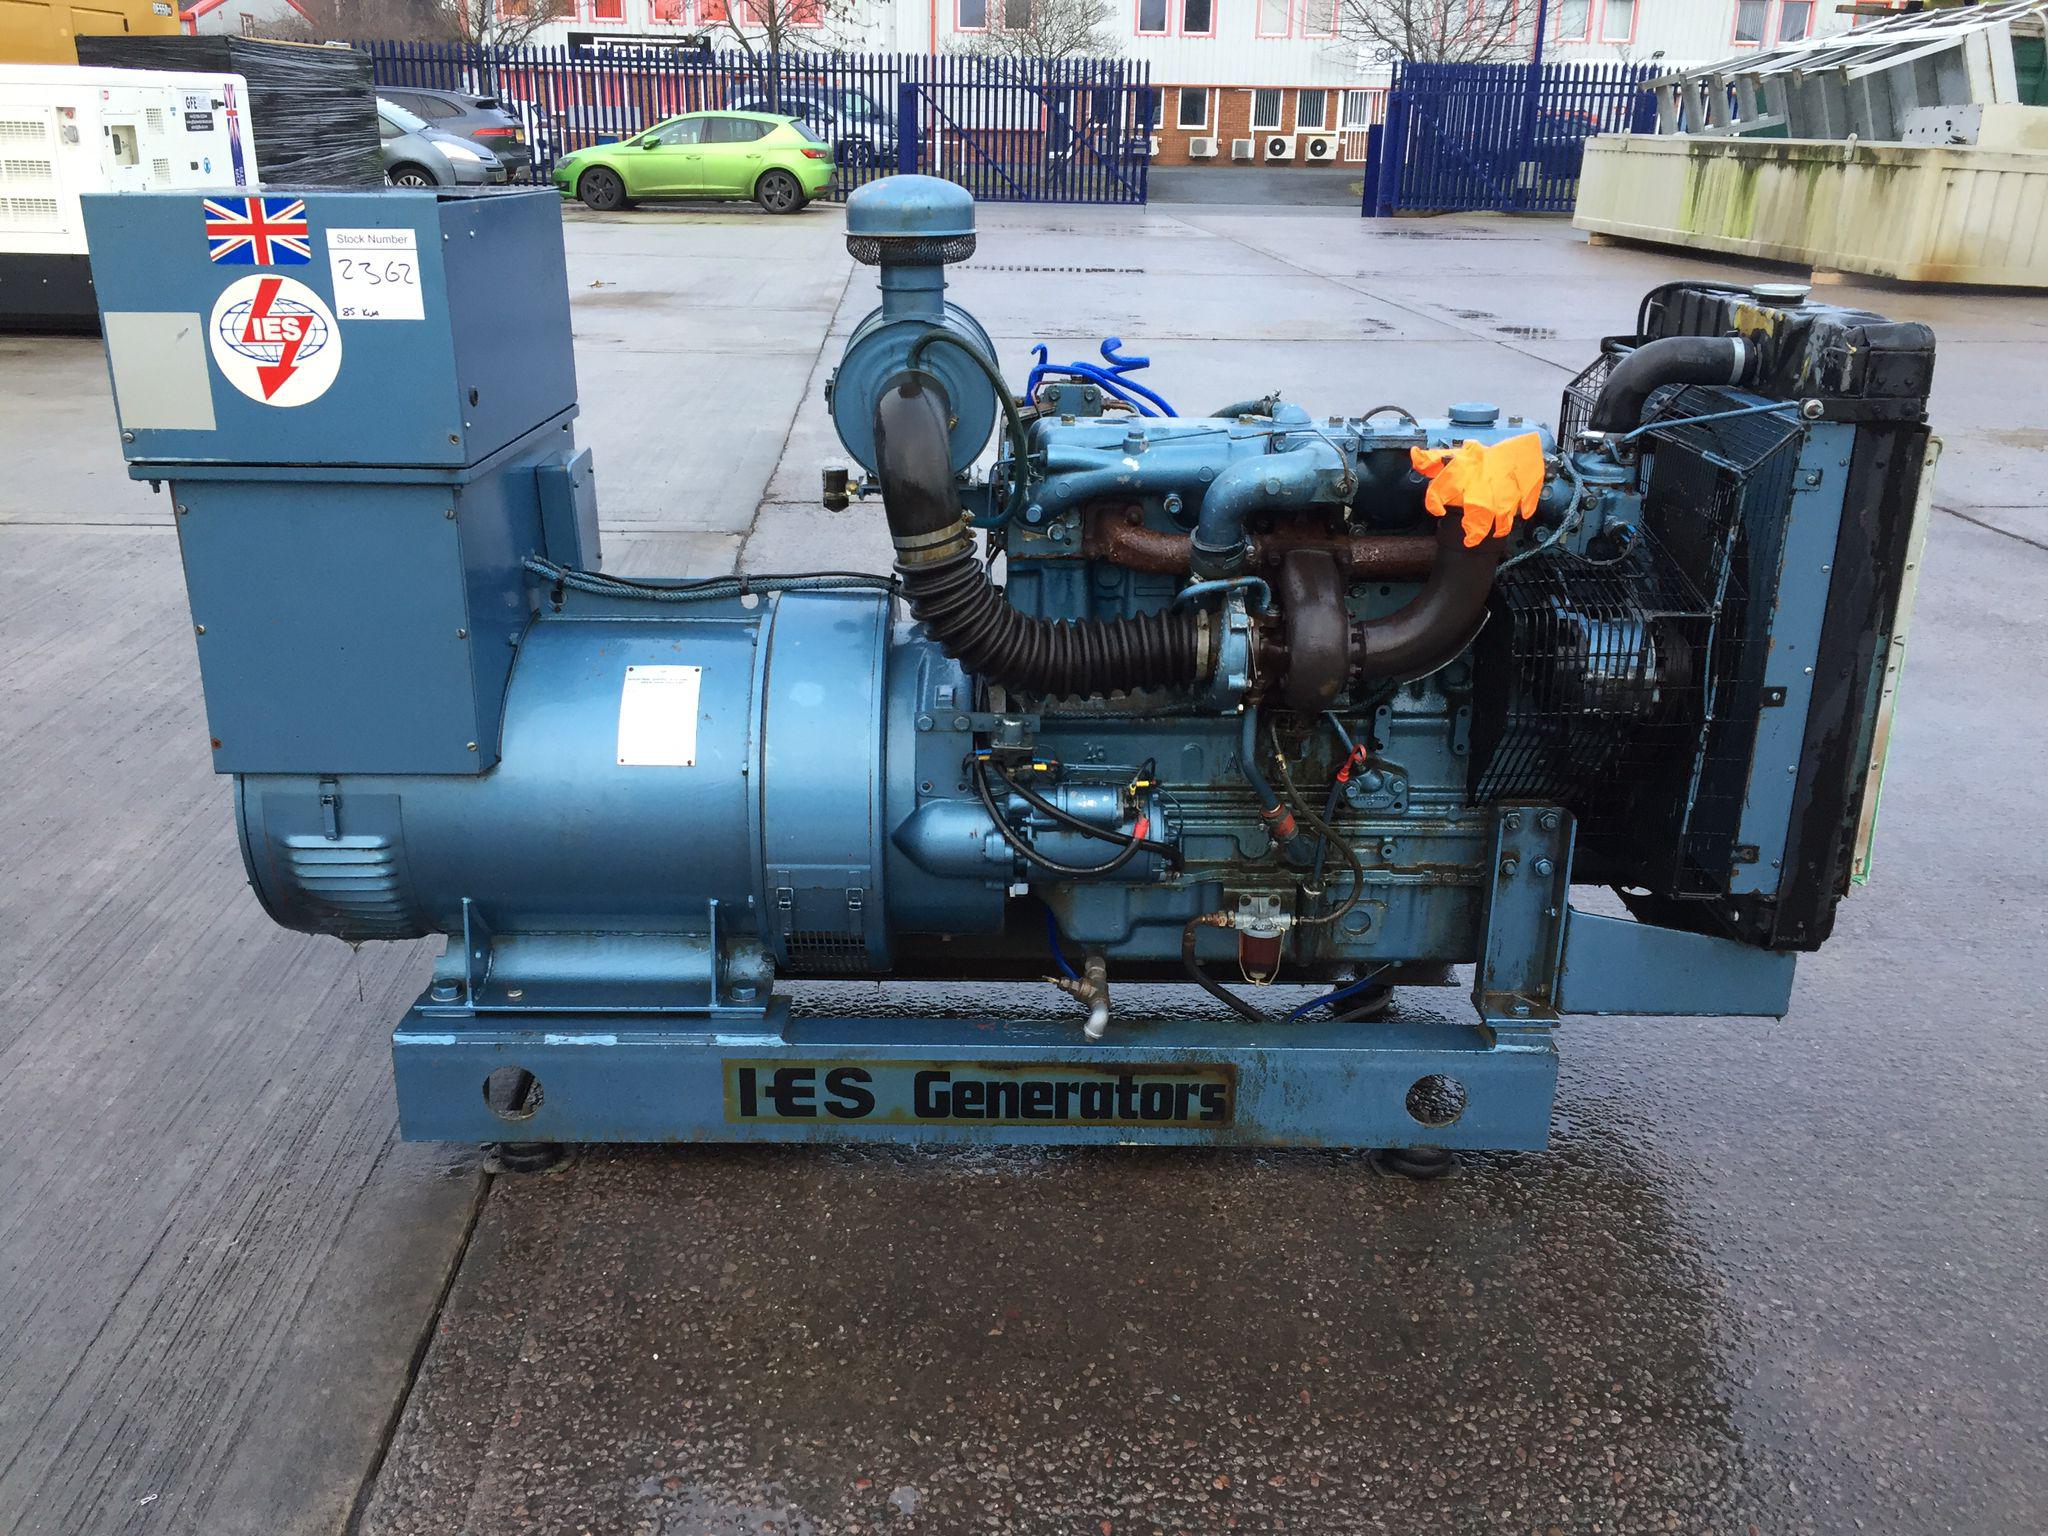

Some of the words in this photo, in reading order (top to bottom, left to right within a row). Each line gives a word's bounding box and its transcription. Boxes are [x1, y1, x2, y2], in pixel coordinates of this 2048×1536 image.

[337, 234, 364, 243] Stock
[368, 234, 408, 243] Number
[338, 259, 414, 285] 2362
[342, 307, 355, 316] 85
[251, 317, 302, 341] IES
[914, 1070, 1226, 1121] Generators
